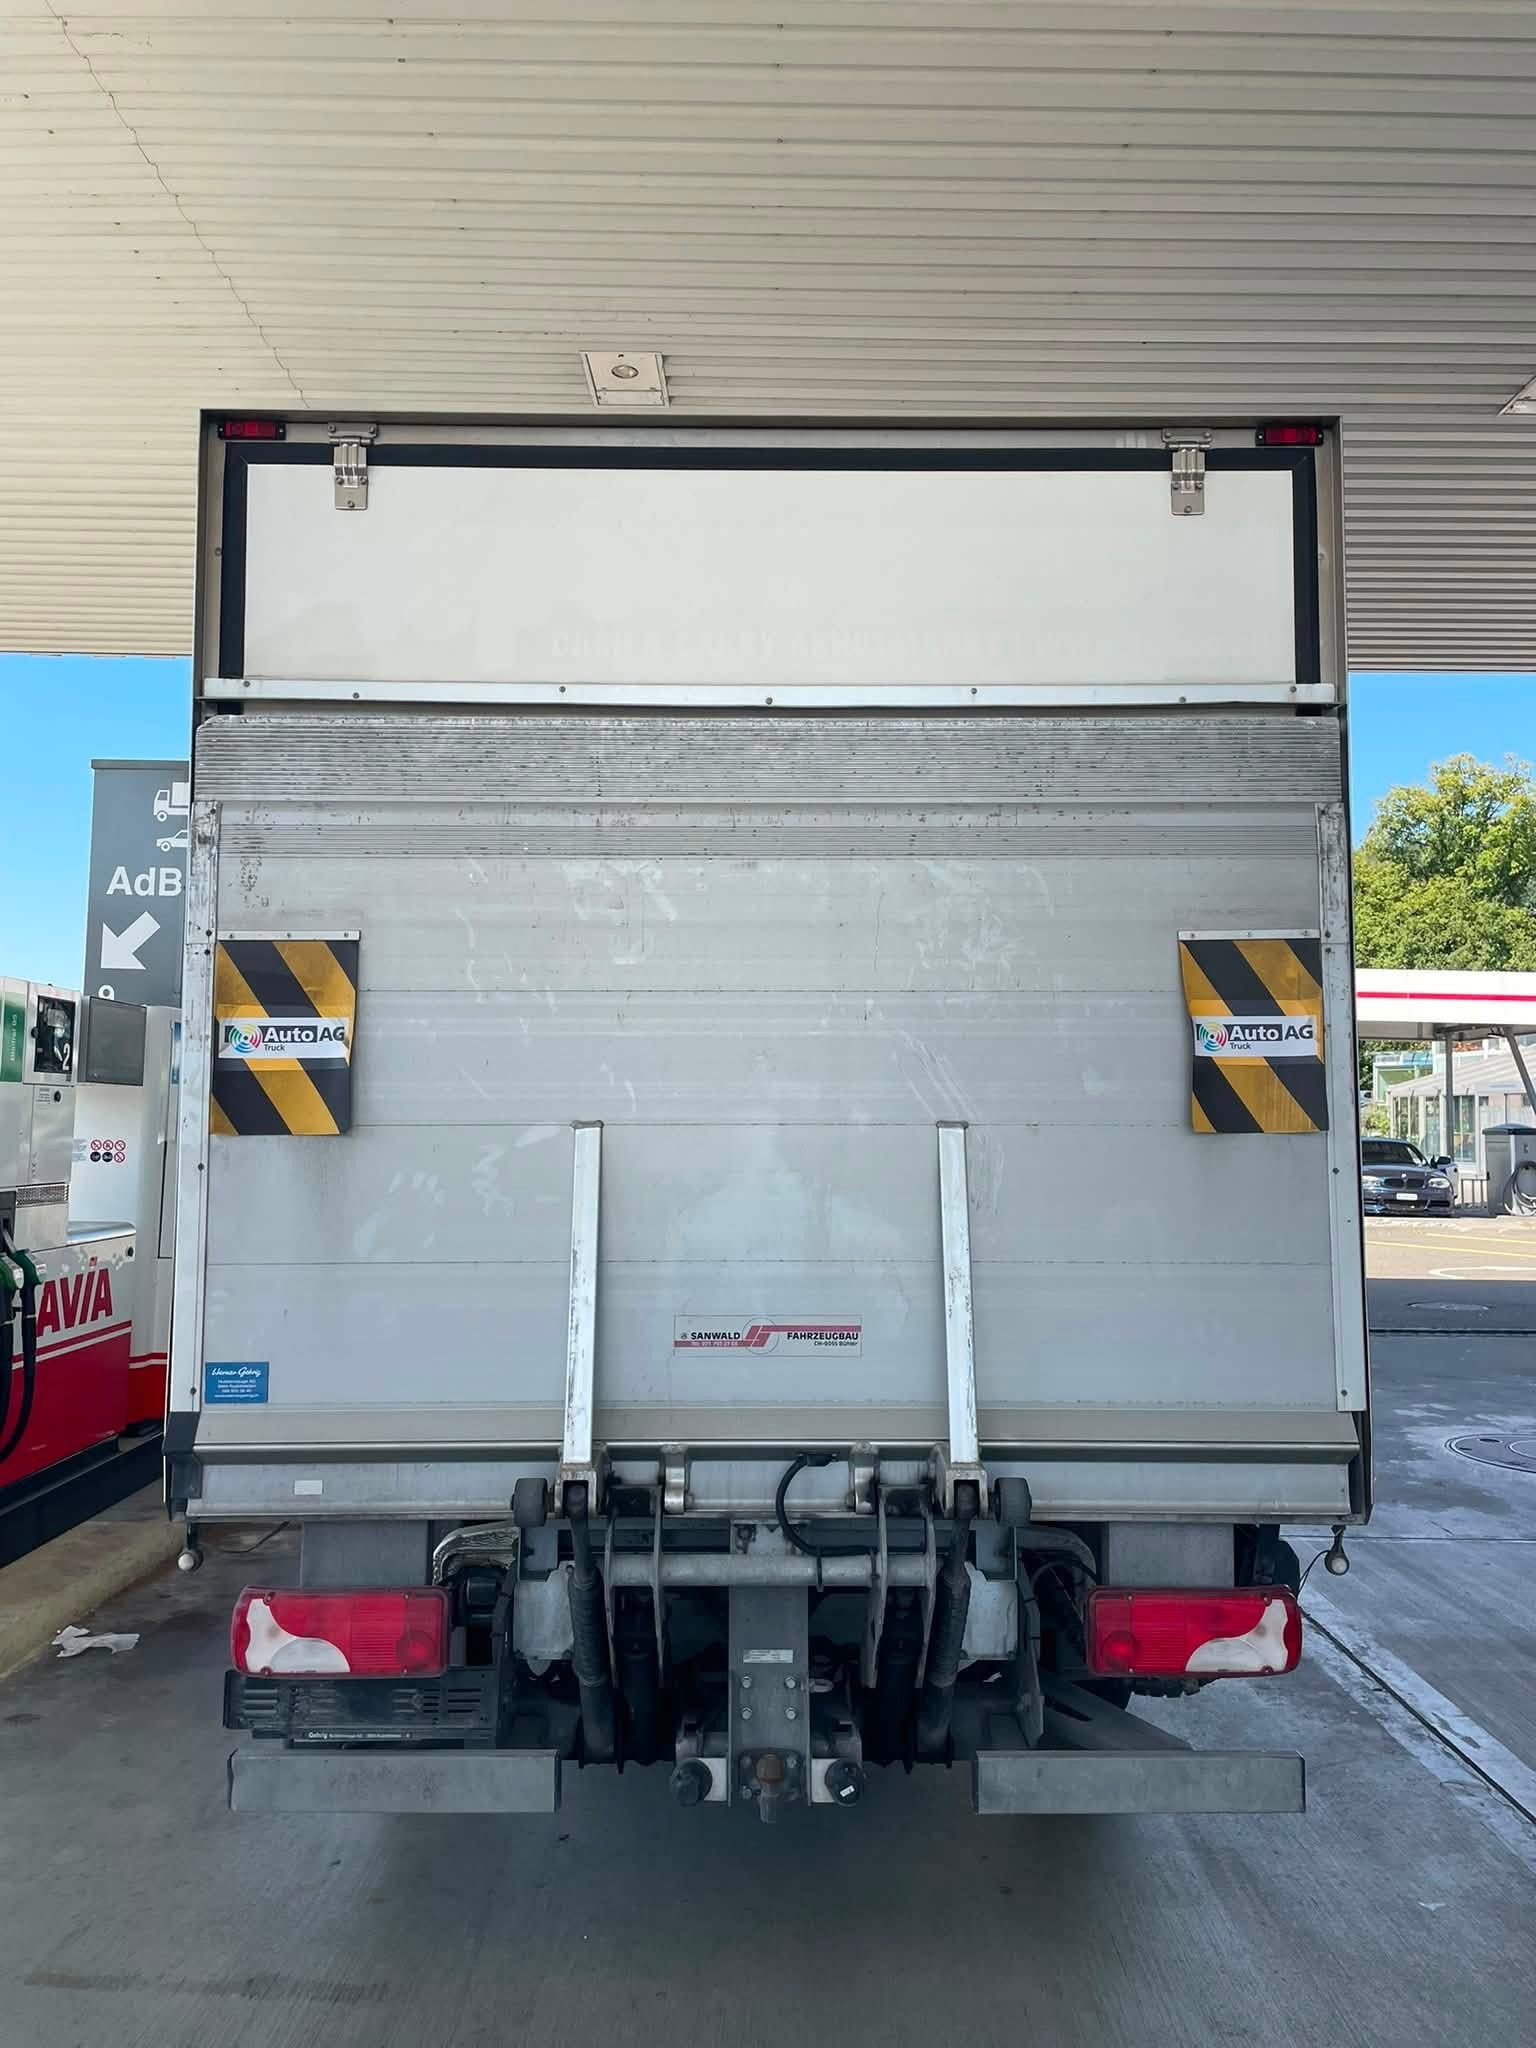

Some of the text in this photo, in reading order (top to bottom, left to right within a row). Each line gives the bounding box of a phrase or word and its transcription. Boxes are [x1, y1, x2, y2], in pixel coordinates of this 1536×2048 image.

[105, 866, 183, 897] AdB
[263, 1026, 345, 1042] Auto AG
[1229, 1024, 1314, 1041] Auto AG
[263, 1043, 286, 1052] Truck
[1229, 1041, 1252, 1050] Truck
[62, 1042, 71, 1071] 2
[690, 1331, 859, 1340] SANWALD FAHRZEUGBAU
